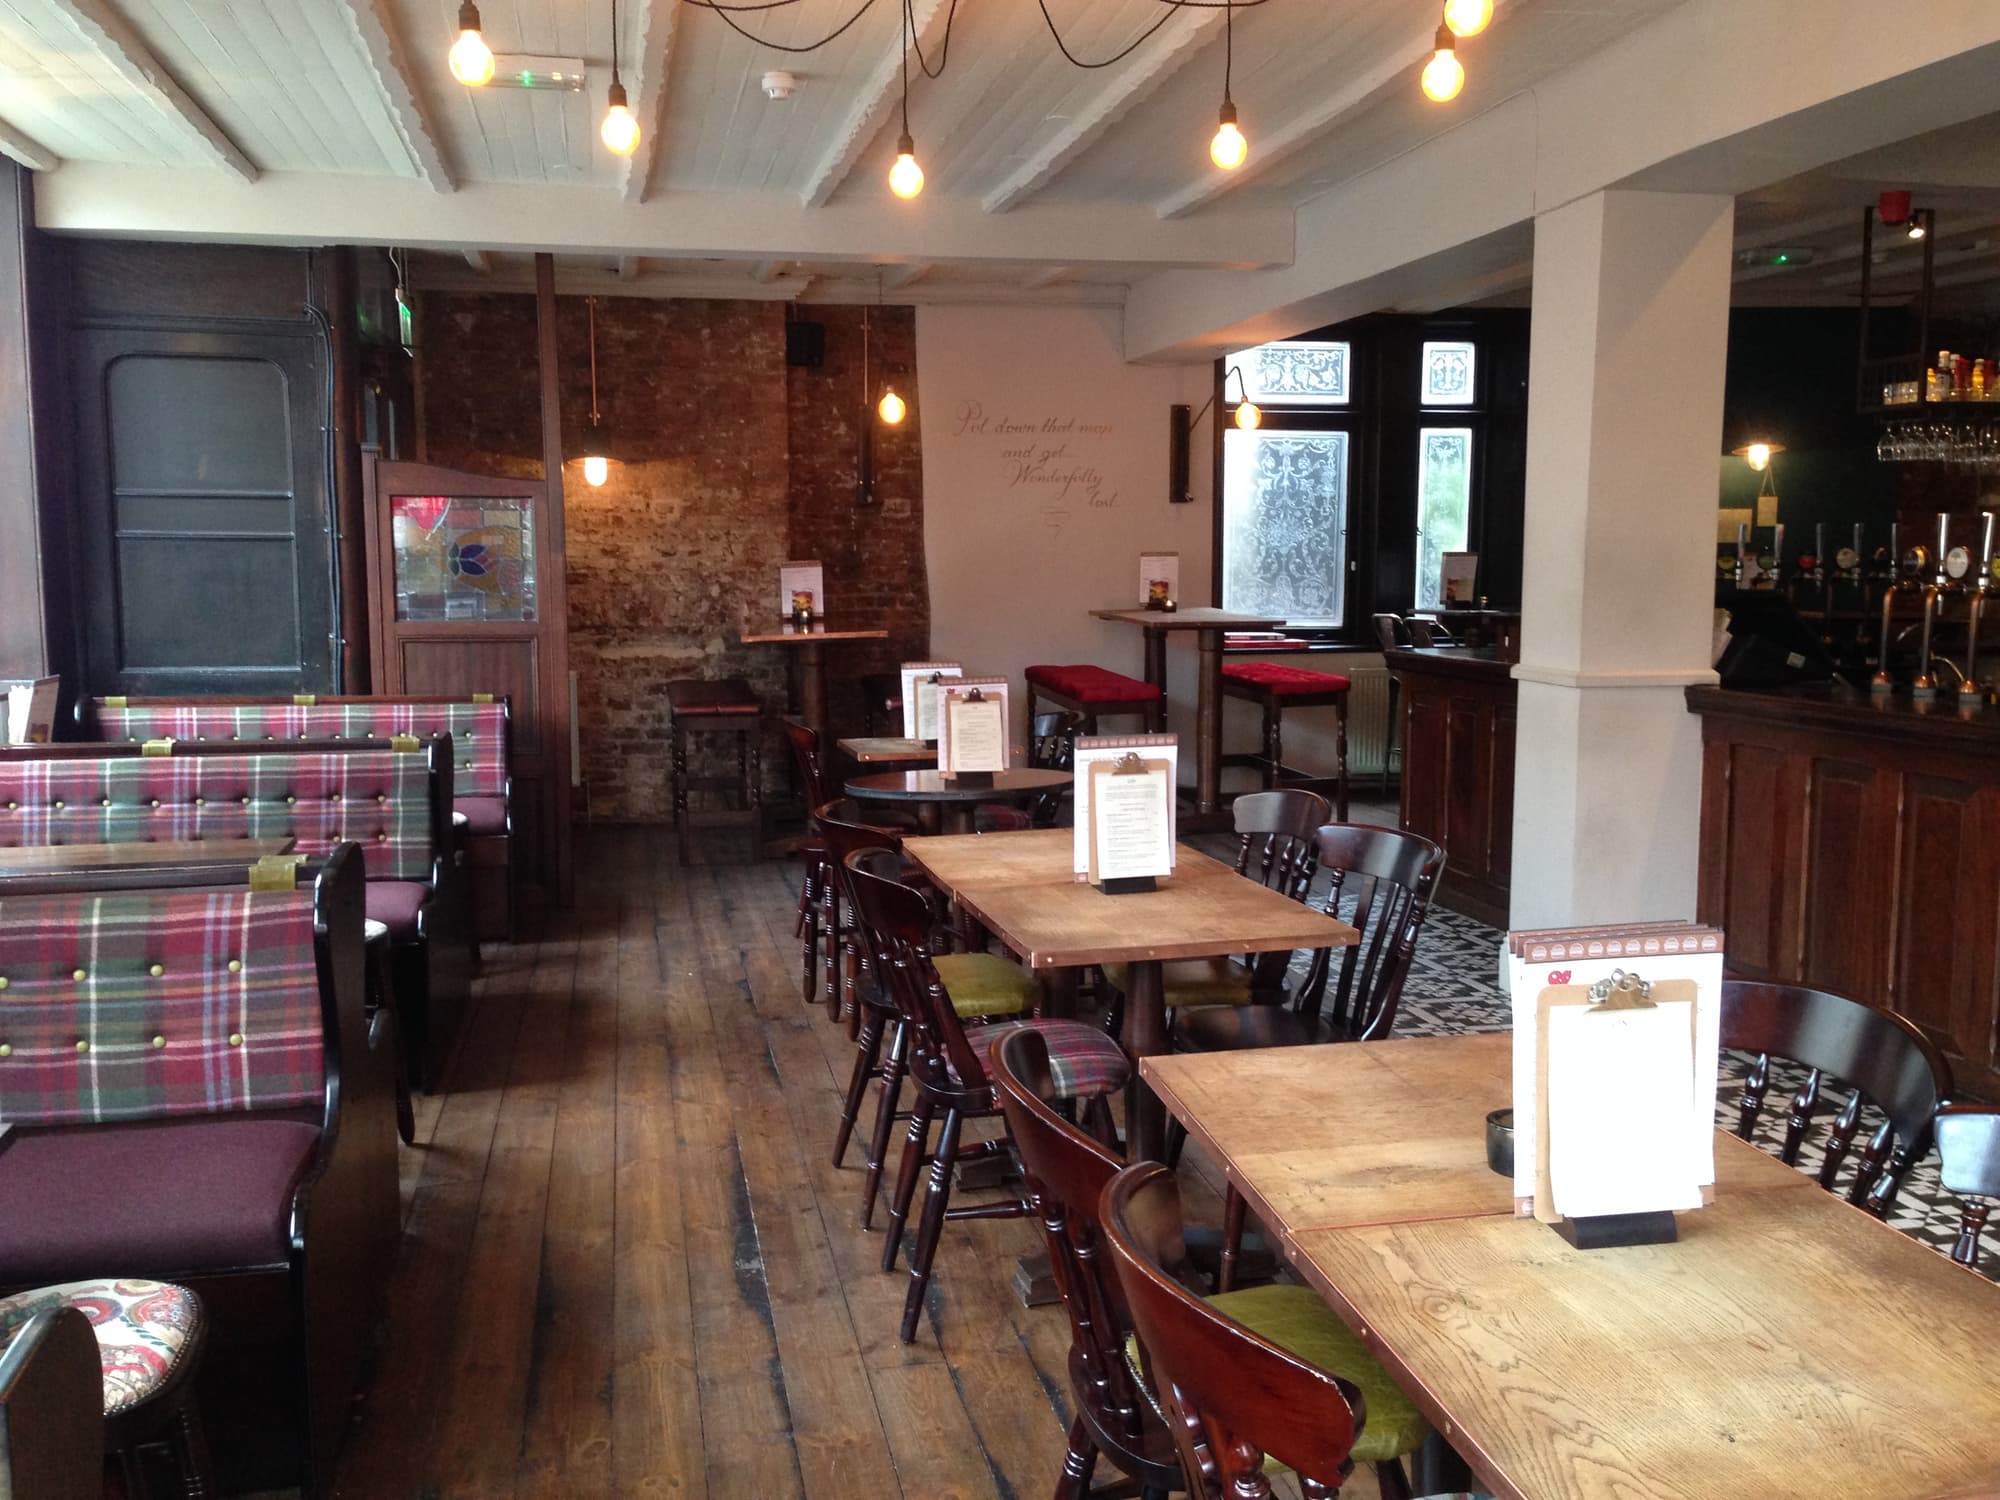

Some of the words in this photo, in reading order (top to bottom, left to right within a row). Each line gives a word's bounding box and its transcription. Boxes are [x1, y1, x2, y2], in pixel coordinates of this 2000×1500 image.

[952, 399, 989, 437] Put
[994, 416, 1036, 434] down
[1041, 416, 1077, 434] that
[1001, 442, 1037, 459] and
[1038, 443, 1068, 463] get
